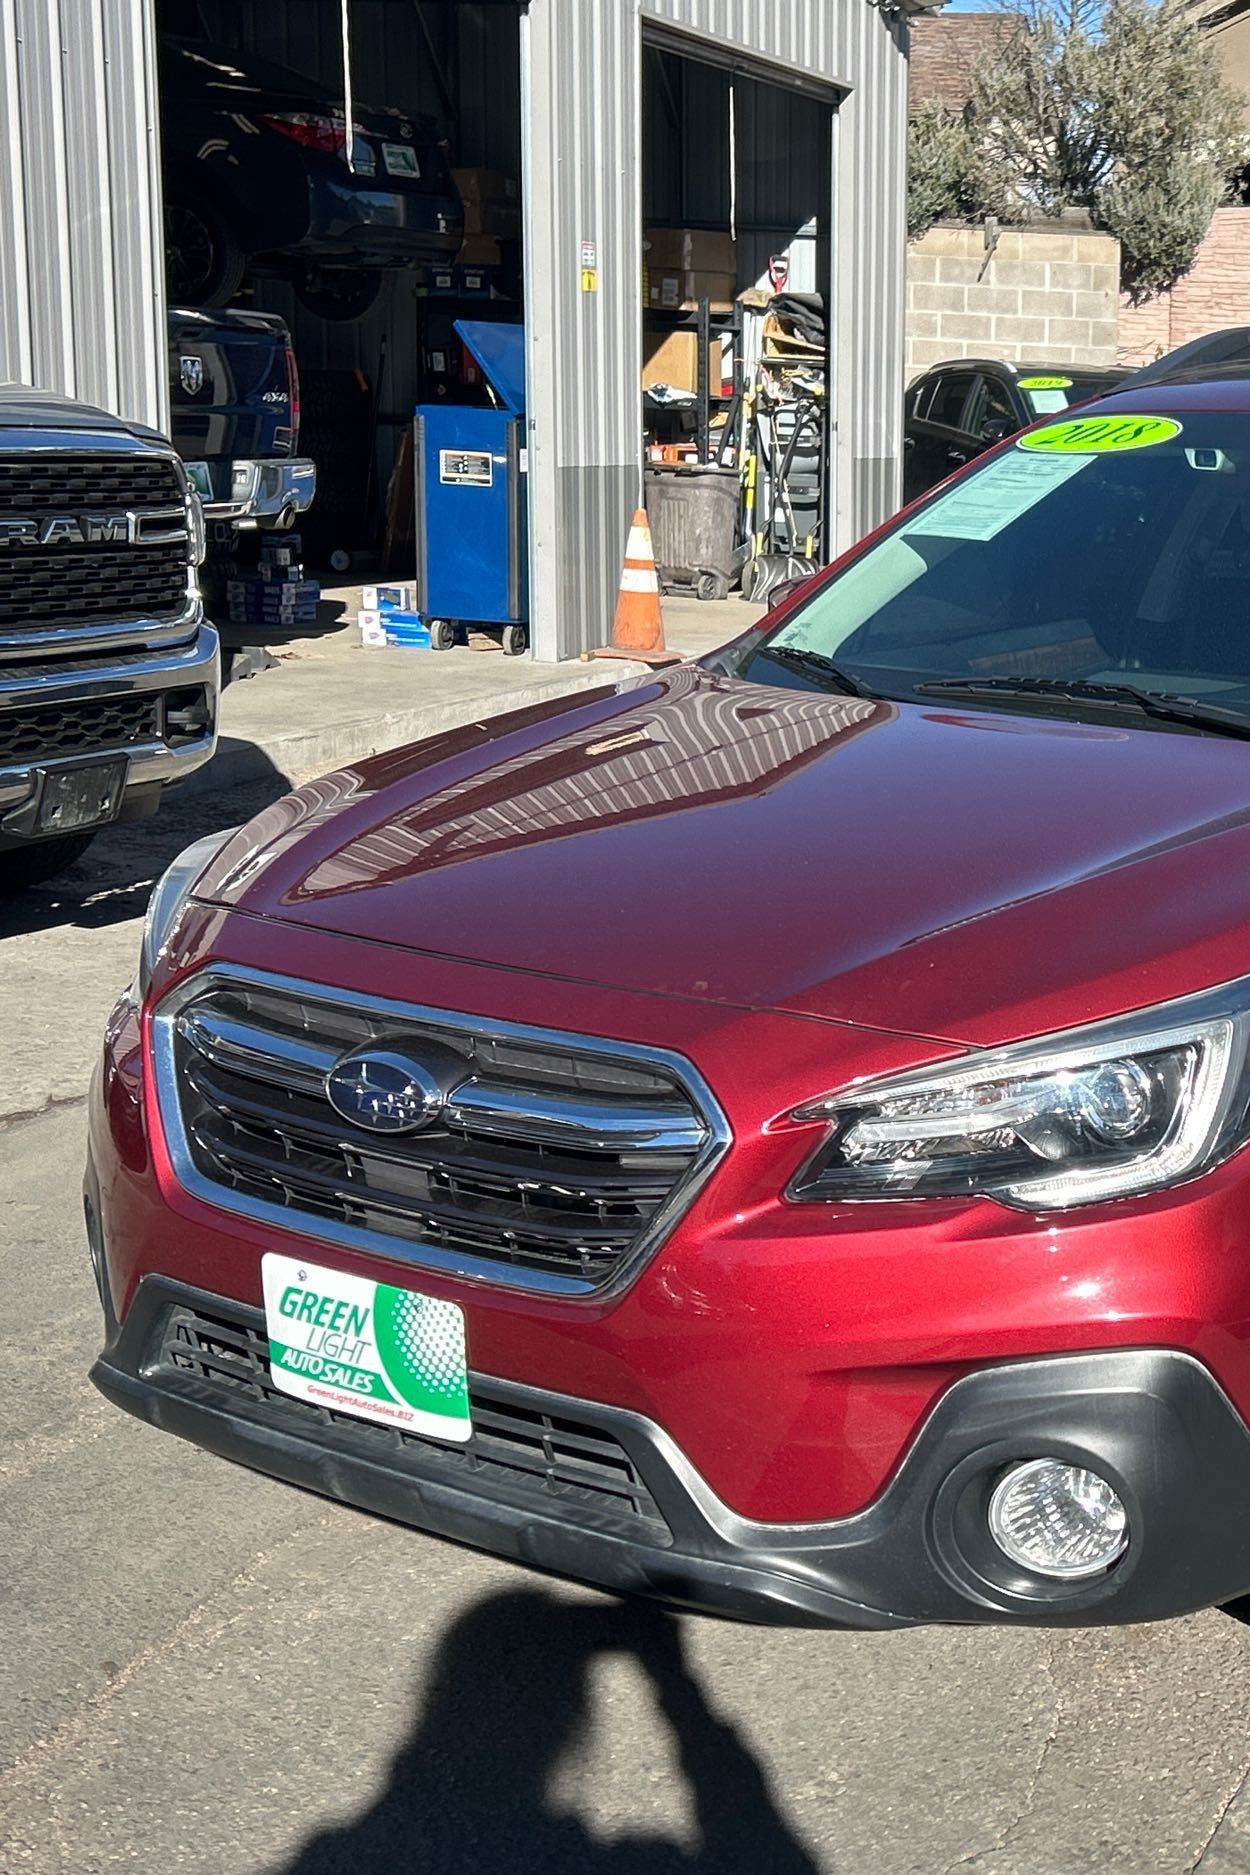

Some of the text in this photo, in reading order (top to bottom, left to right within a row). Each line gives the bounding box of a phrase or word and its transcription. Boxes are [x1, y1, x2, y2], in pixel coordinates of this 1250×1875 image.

[1035, 422, 1161, 446] 2018
[0, 514, 127, 546] RAM
[278, 1285, 370, 1338] GREEN
[305, 1327, 372, 1365] LIGHT
[280, 1349, 375, 1394] AUTO SALES
